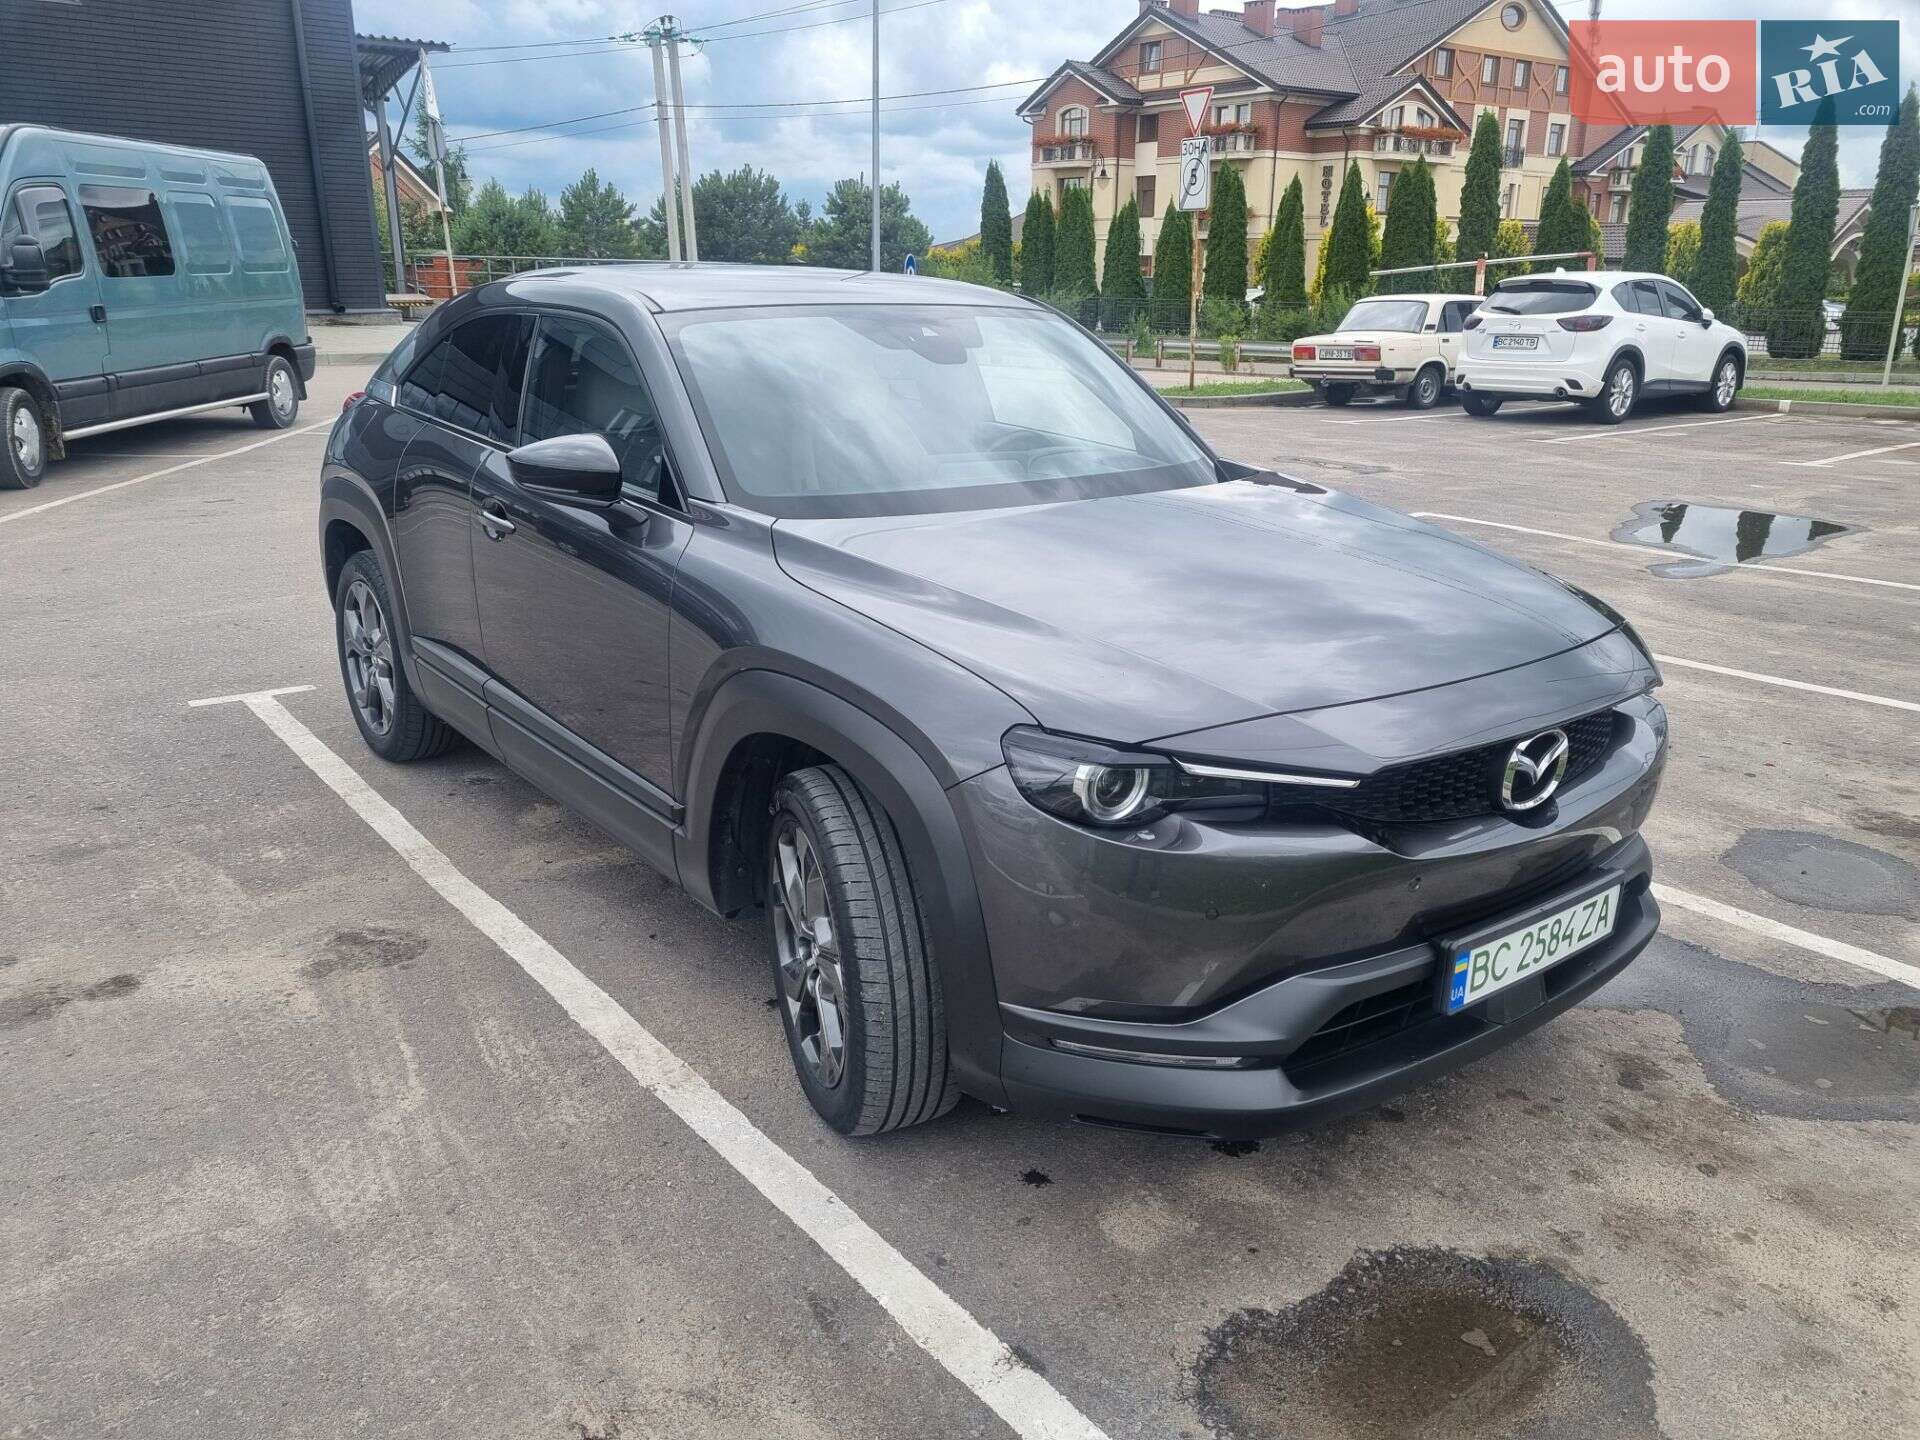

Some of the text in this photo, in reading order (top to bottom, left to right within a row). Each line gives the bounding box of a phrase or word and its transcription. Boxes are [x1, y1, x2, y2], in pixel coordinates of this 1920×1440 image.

[1183, 141, 1208, 156] ЗОНА
[1190, 168, 1197, 186] 5
[1319, 165, 1334, 228] HOTEL
[1469, 893, 1610, 993] BC 2584 ZA
[1451, 985, 1464, 1001] UA
